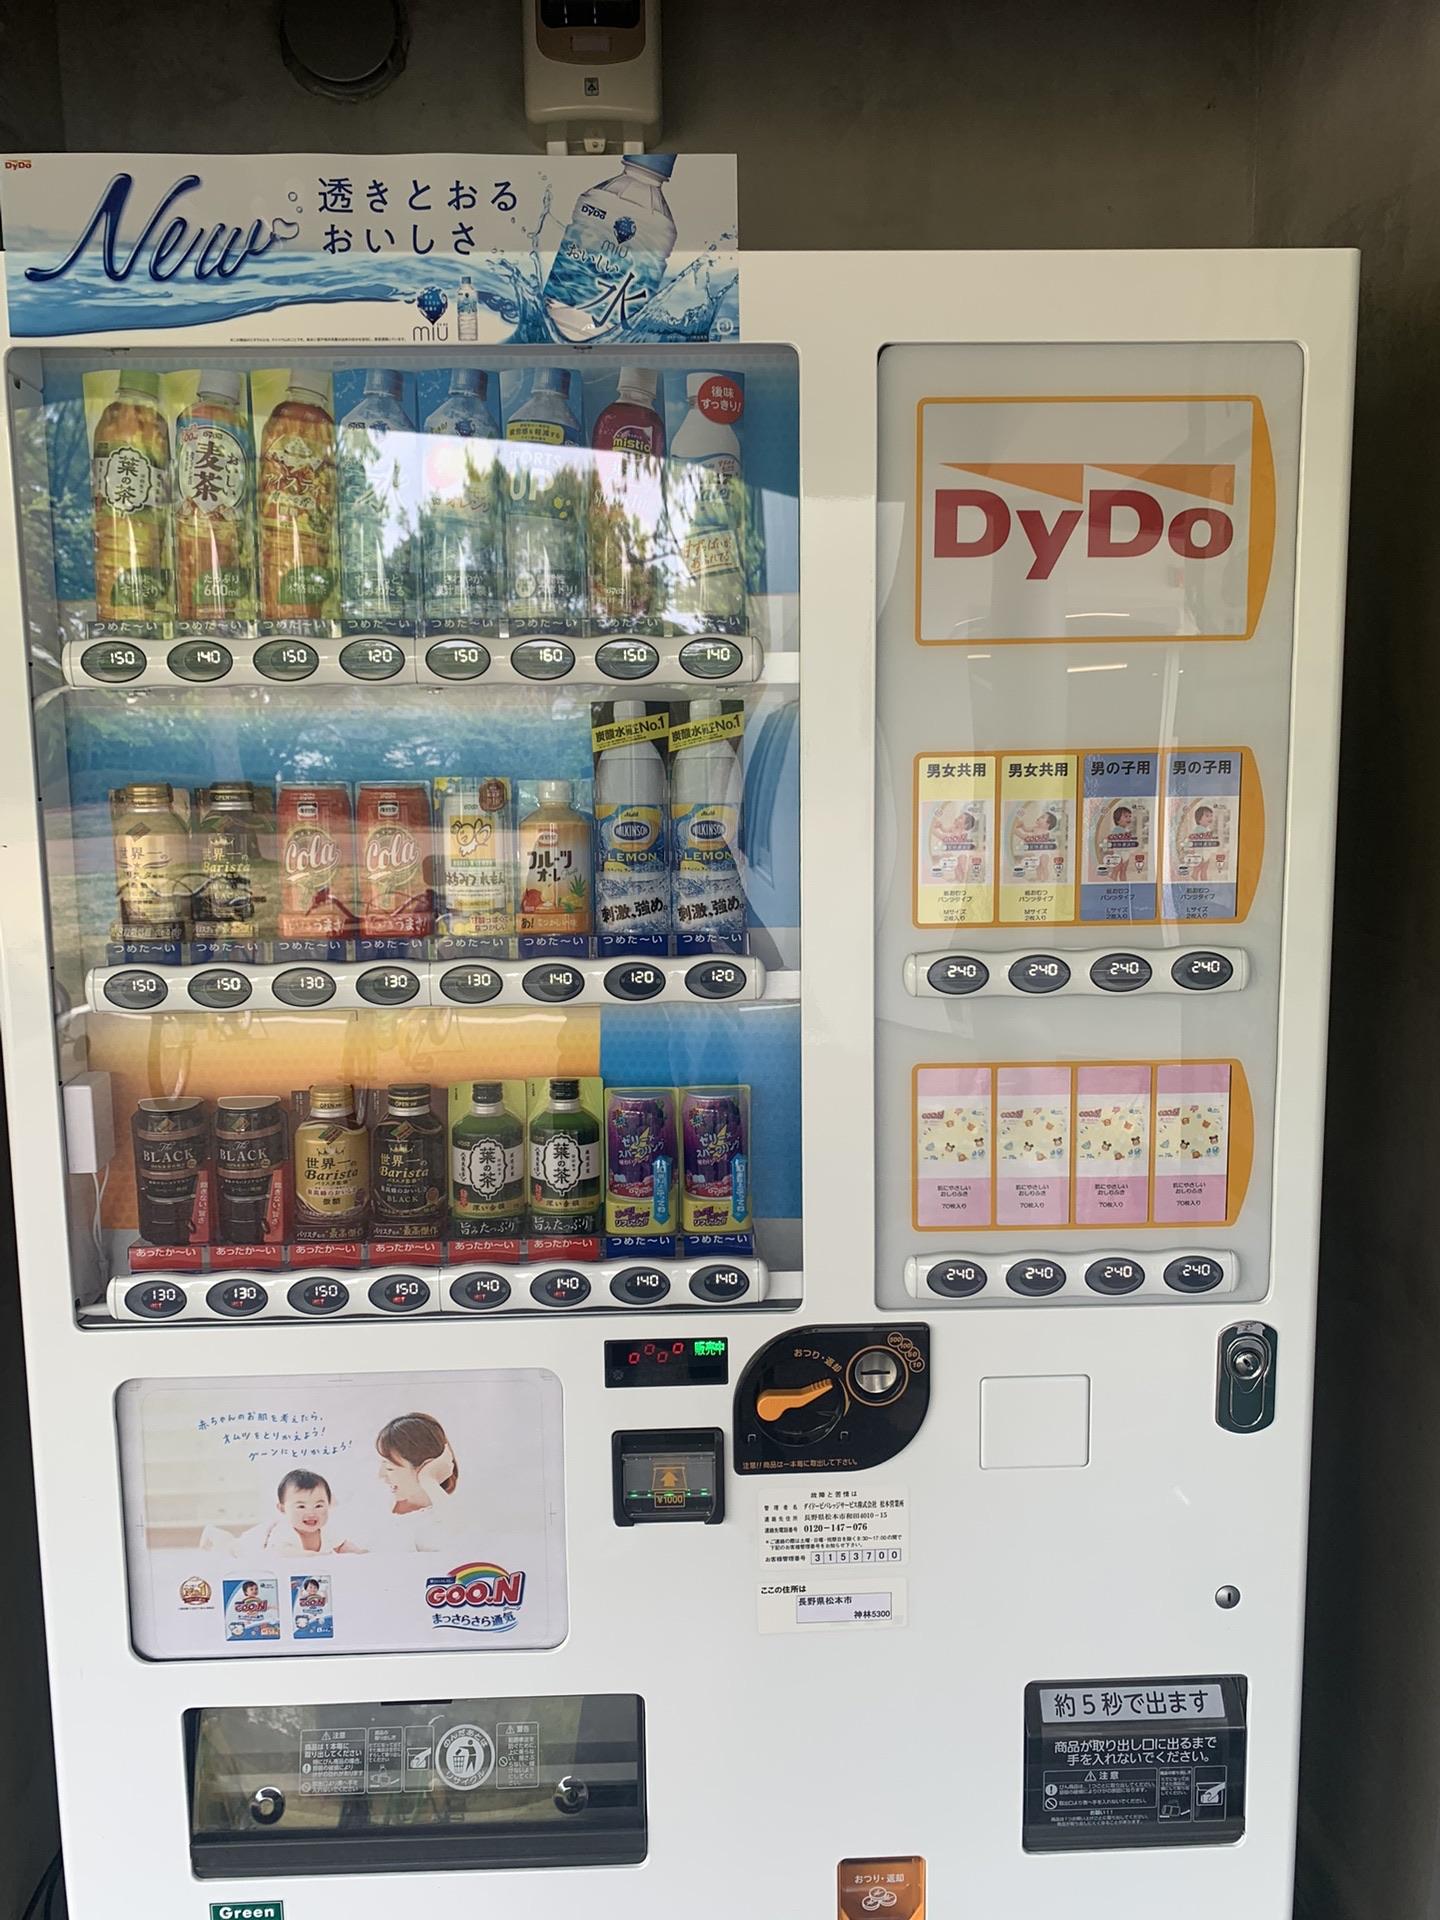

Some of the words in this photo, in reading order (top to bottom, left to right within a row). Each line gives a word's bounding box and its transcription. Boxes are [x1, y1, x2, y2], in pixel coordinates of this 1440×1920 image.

[5, 160, 32, 170] DyDo
[318, 177, 518, 214] 透きとおる
[581, 204, 607, 220] DyDo
[25, 172, 275, 282] New
[322, 222, 476, 255] おいしさ
[565, 243, 619, 273] おいしい
[586, 272, 648, 330] 水
[710, 385, 735, 398] 後味
[192, 440, 226, 502] 麦茶
[222, 452, 240, 497] おいしい
[114, 455, 140, 505] 葉の茶
[933, 488, 1235, 580] DyDo
[110, 651, 135, 665] 150
[196, 650, 221, 664] 140
[281, 649, 307, 664] 150
[367, 649, 393, 663] 120
[453, 649, 478, 663] 150
[538, 649, 563, 662] 160
[622, 649, 647, 662] 150
[705, 647, 730, 661] 140
[926, 762, 987, 778] 男女共用
[1008, 762, 1069, 778] 男女共用
[1090, 760, 1151, 776] 男の子用
[1172, 760, 1232, 775] 男の子用
[285, 833, 337, 875] Cola
[366, 832, 418, 873] Cola
[608, 852, 657, 862] LEMON
[684, 851, 733, 861] LEMON
[202, 860, 251, 873] Barista
[947, 964, 977, 978] 240
[1028, 963, 1058, 976] 240
[1110, 962, 1139, 975] 240
[1191, 960, 1220, 974] 240
[299, 976, 324, 989] 130
[383, 975, 408, 988] 130
[467, 973, 491, 987] 130
[549, 972, 572, 985] 140
[630, 971, 654, 984] 120
[710, 970, 734, 982] 120
[131, 979, 156, 992] 150
[216, 977, 241, 991] 150
[143, 1148, 194, 1163] BLACK
[219, 1148, 268, 1162] BLACK
[380, 1153, 428, 1167] 世界一の
[306, 1157, 357, 1170] 世界一の
[479, 1146, 496, 1189] 葉の茶
[553, 1142, 571, 1185] 葉の茶
[304, 1168, 359, 1181] Barista
[379, 1166, 430, 1178] Barista
[386, 1195, 419, 1203] BLACK
[460, 1221, 516, 1236] 旨みたっぷり
[534, 1217, 589, 1232] 旨みたっぷり
[946, 1267, 975, 1281] 240
[1025, 1266, 1053, 1279] 240
[1104, 1265, 1132, 1278] 240
[1182, 1264, 1211, 1277] 240
[476, 1279, 500, 1292] 140
[555, 1277, 579, 1290] 140
[635, 1275, 659, 1287] 140
[715, 1273, 738, 1285] 140
[151, 1288, 176, 1300] 130
[232, 1287, 257, 1299] 130
[314, 1285, 338, 1297] 150
[394, 1282, 419, 1295] 150
[889, 1336, 902, 1344] 500
[694, 1340, 725, 1356] 販売中
[656, 1494, 684, 1506] ¥1000
[760, 1585, 807, 1595] ここの住所は
[798, 1596, 853, 1606] 長野県松本市
[432, 1611, 517, 1627] まっさらさら通気
[854, 1610, 891, 1619] 神林5300
[1053, 1690, 1209, 1718] 約5秒で出ます
[1054, 1736, 1217, 1754] 商品が取り出し口に出るまで
[1066, 1751, 1210, 1766] 手を入れないでください。
[1098, 1771, 1119, 1780] 注意
[219, 1904, 275, 1919] Green
